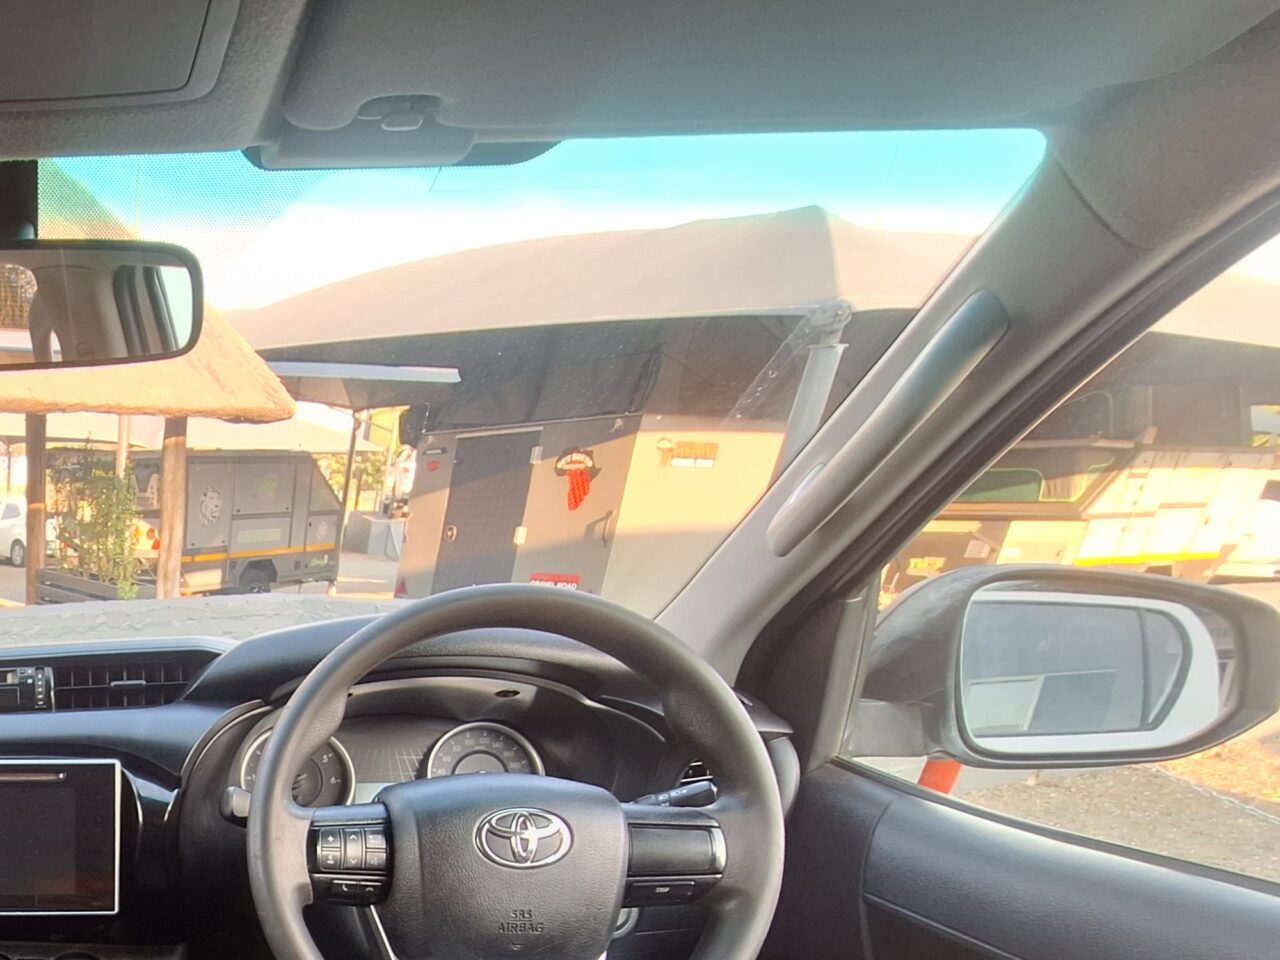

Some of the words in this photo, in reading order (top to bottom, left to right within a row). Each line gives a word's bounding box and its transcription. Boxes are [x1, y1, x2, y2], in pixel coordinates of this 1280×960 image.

[321, 755, 328, 763] 5
[330, 776, 336, 784] 6
[510, 909, 533, 919] SRS
[497, 922, 544, 933] AIRBAG
